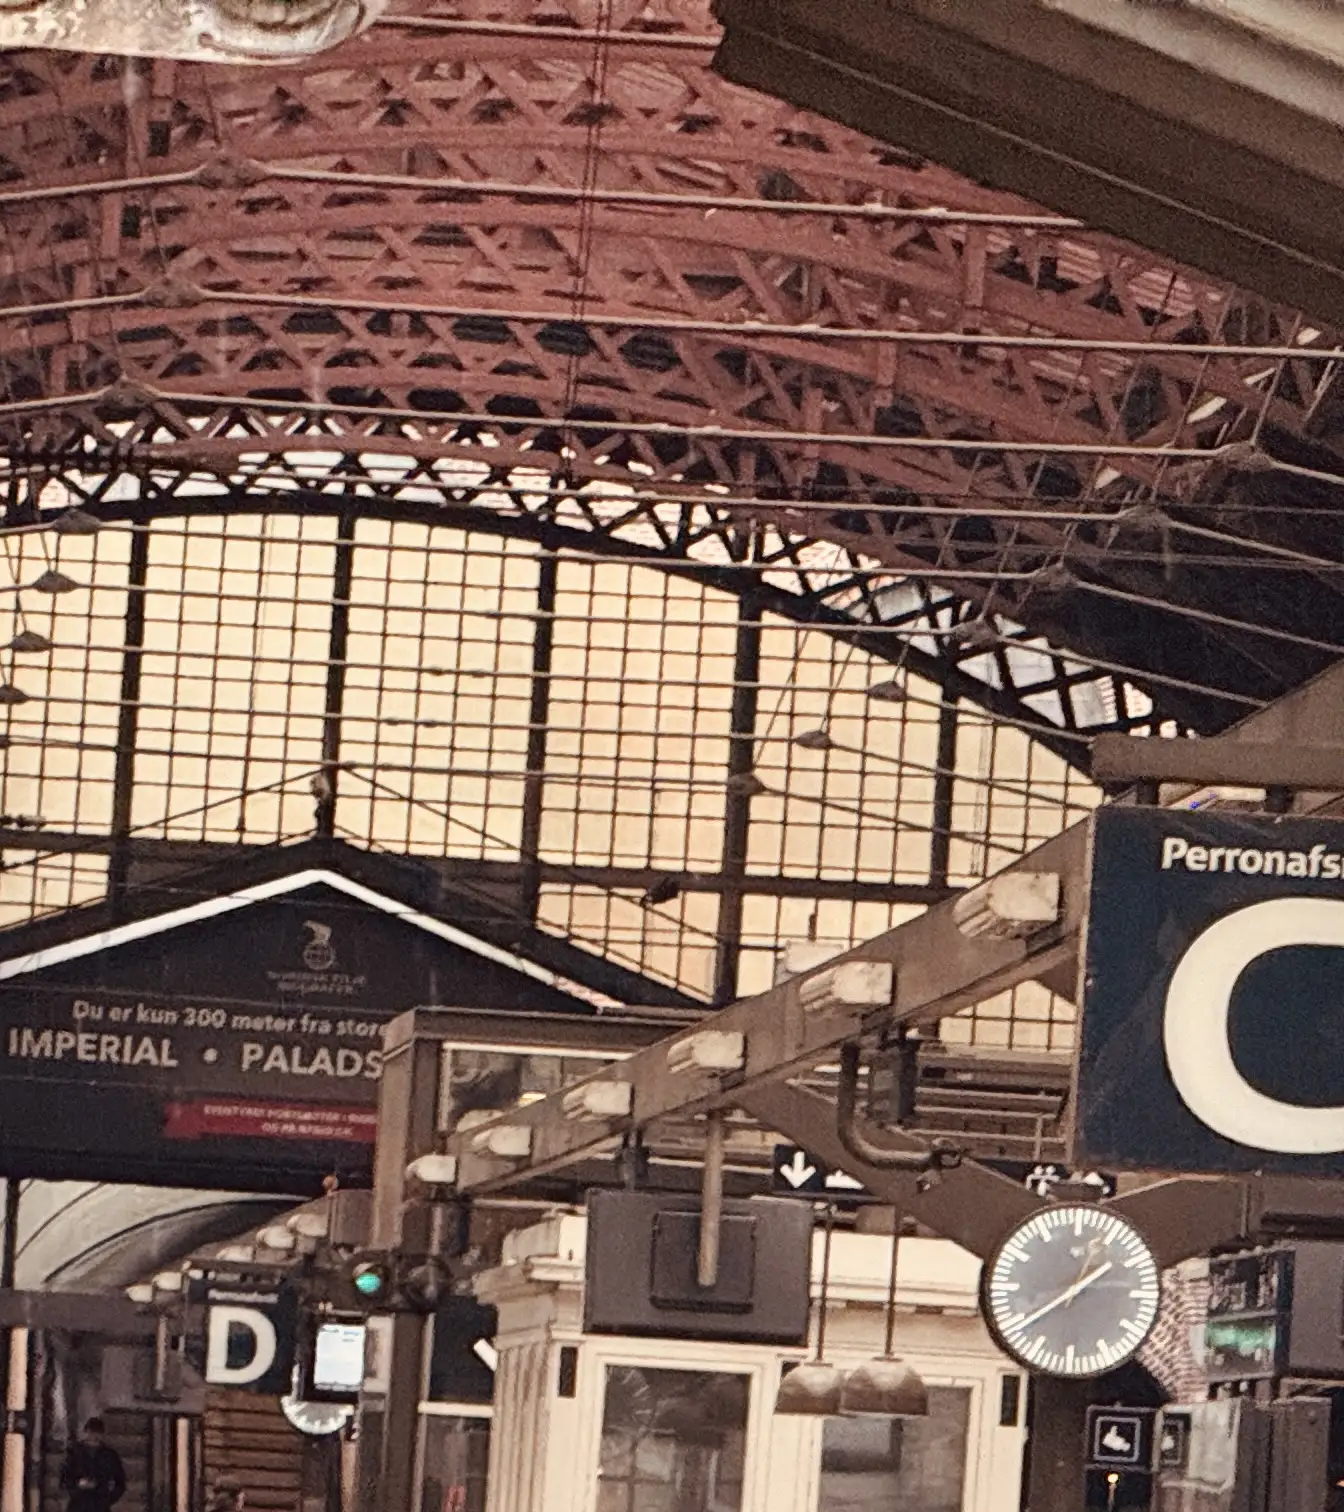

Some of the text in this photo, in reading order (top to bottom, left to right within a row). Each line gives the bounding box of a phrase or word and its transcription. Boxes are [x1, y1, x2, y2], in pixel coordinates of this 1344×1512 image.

[72, 1000, 104, 1021] Du
[109, 1005, 130, 1022] er
[137, 1002, 178, 1025] kun
[232, 1012, 297, 1034] meter
[300, 1013, 332, 1035] fra
[1164, 897, 1344, 1154] C
[8, 1027, 384, 1080] IMPERIAL PALADS
[205, 1305, 277, 1384] D
